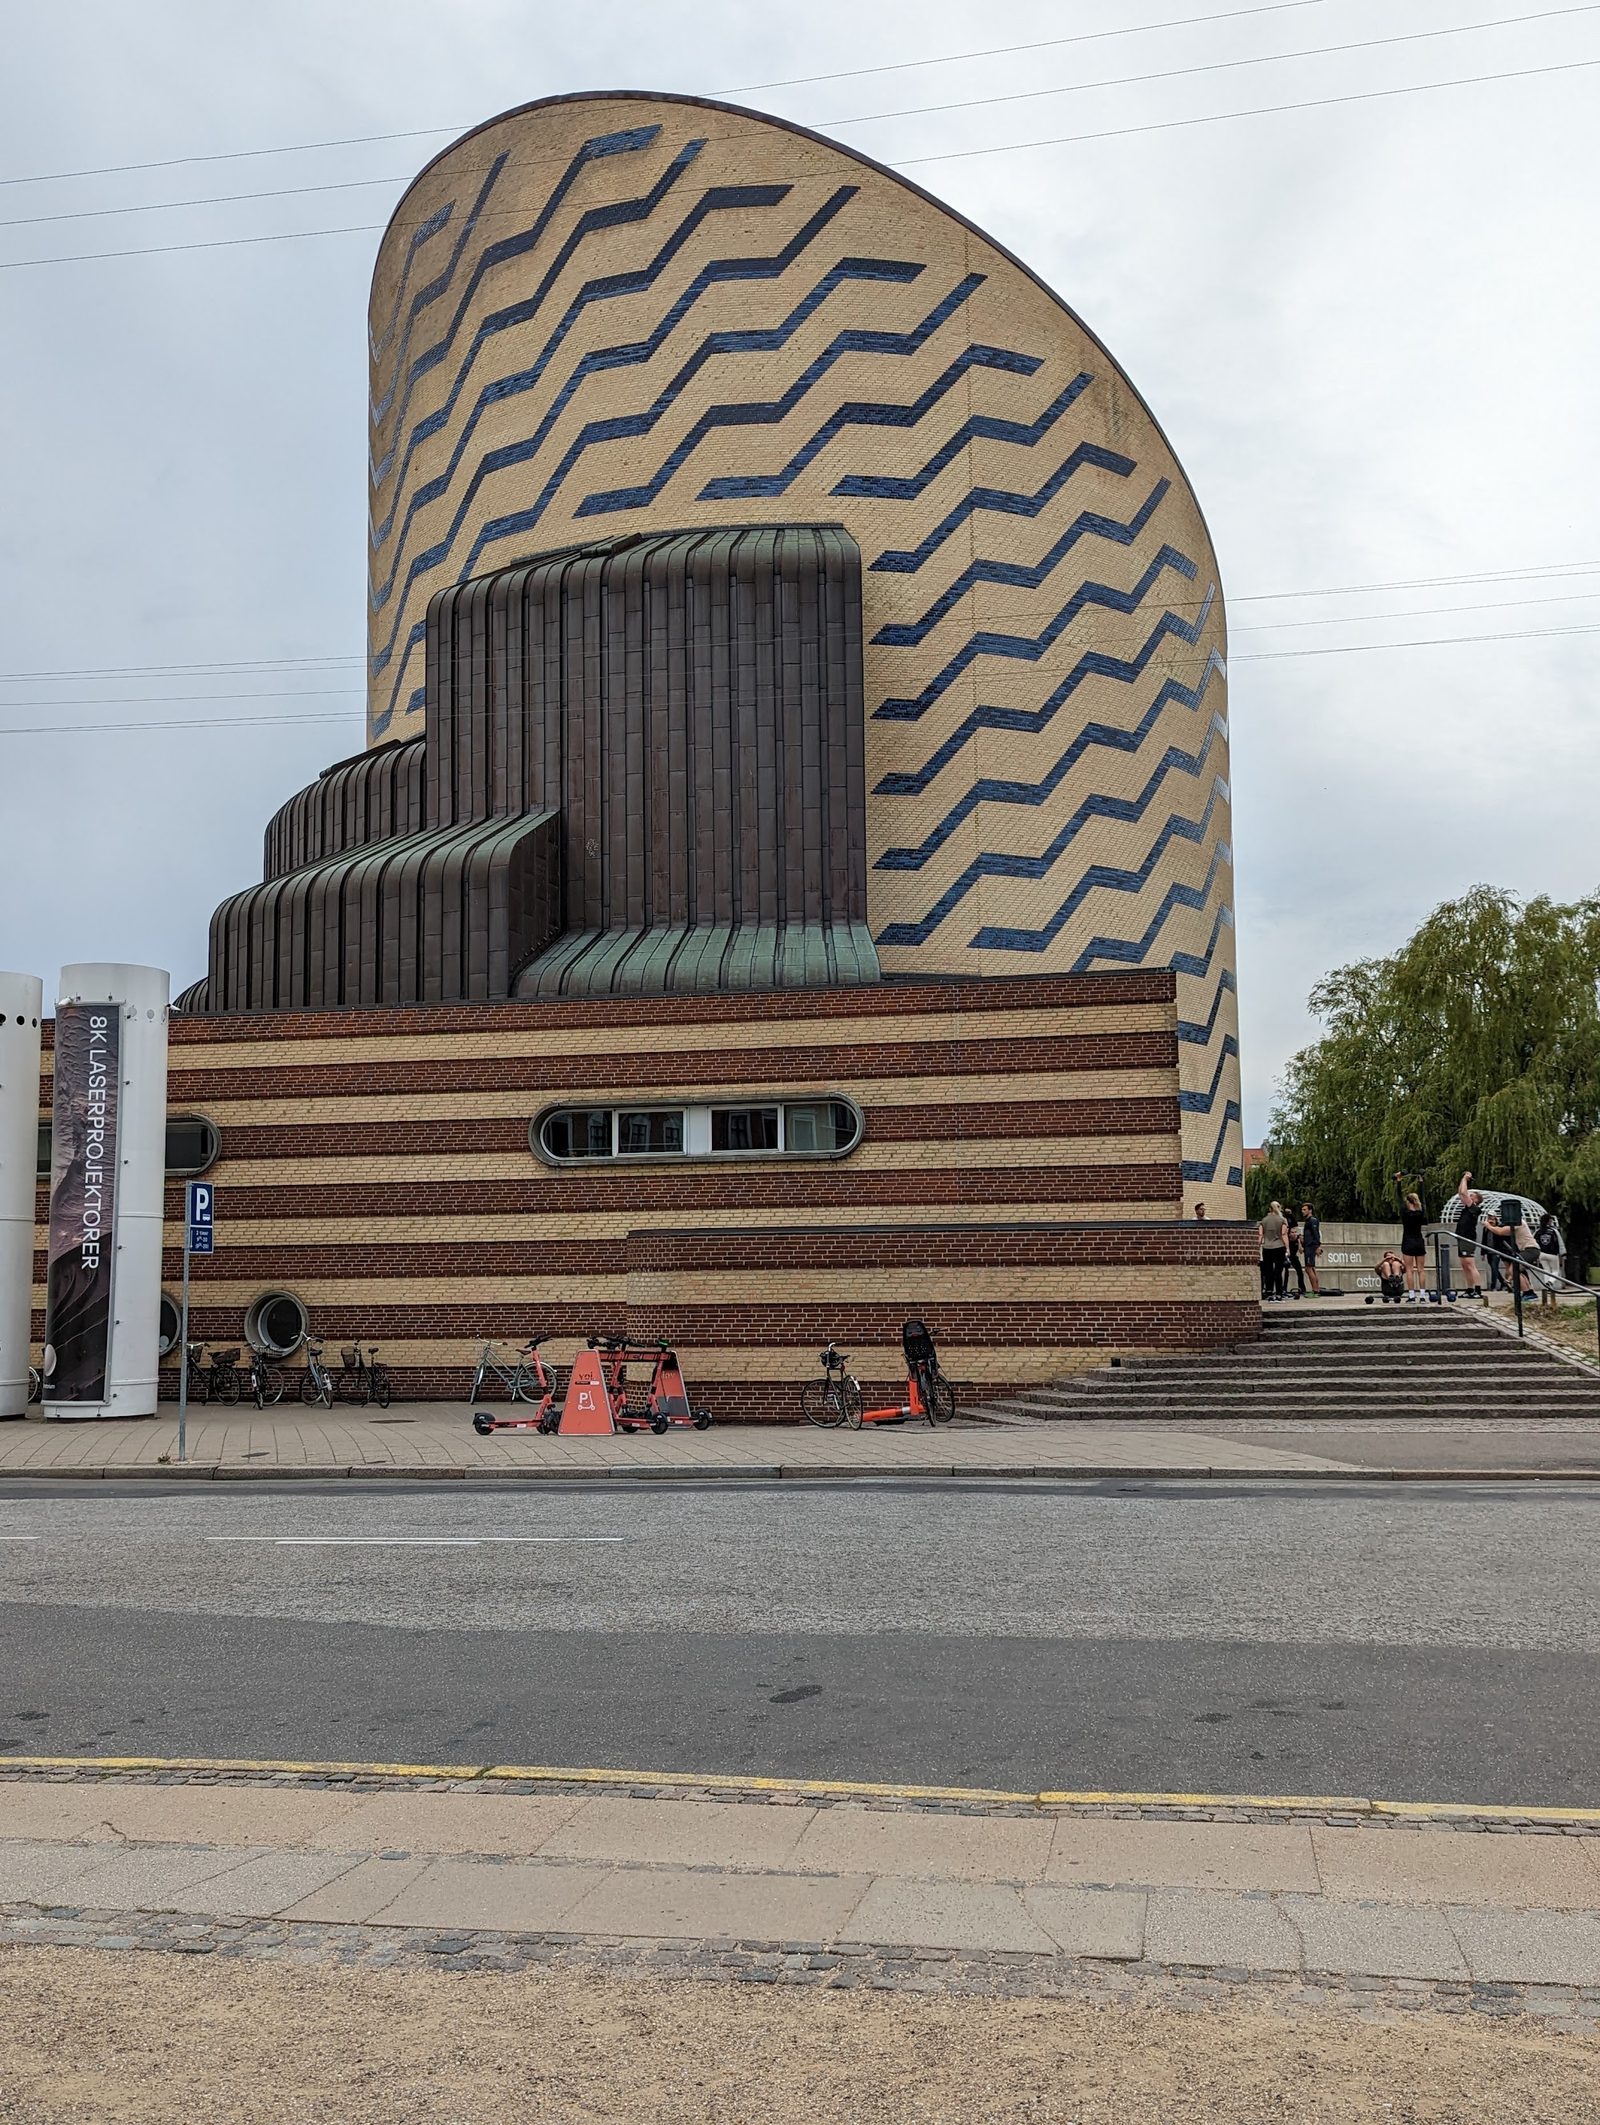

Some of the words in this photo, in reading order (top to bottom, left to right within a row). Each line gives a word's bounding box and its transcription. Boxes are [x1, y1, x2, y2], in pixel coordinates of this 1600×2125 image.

[89, 1015, 108, 1043] 8K
[81, 1049, 107, 1270] LASERPROJEKTORER
[195, 1187, 210, 1222] P
